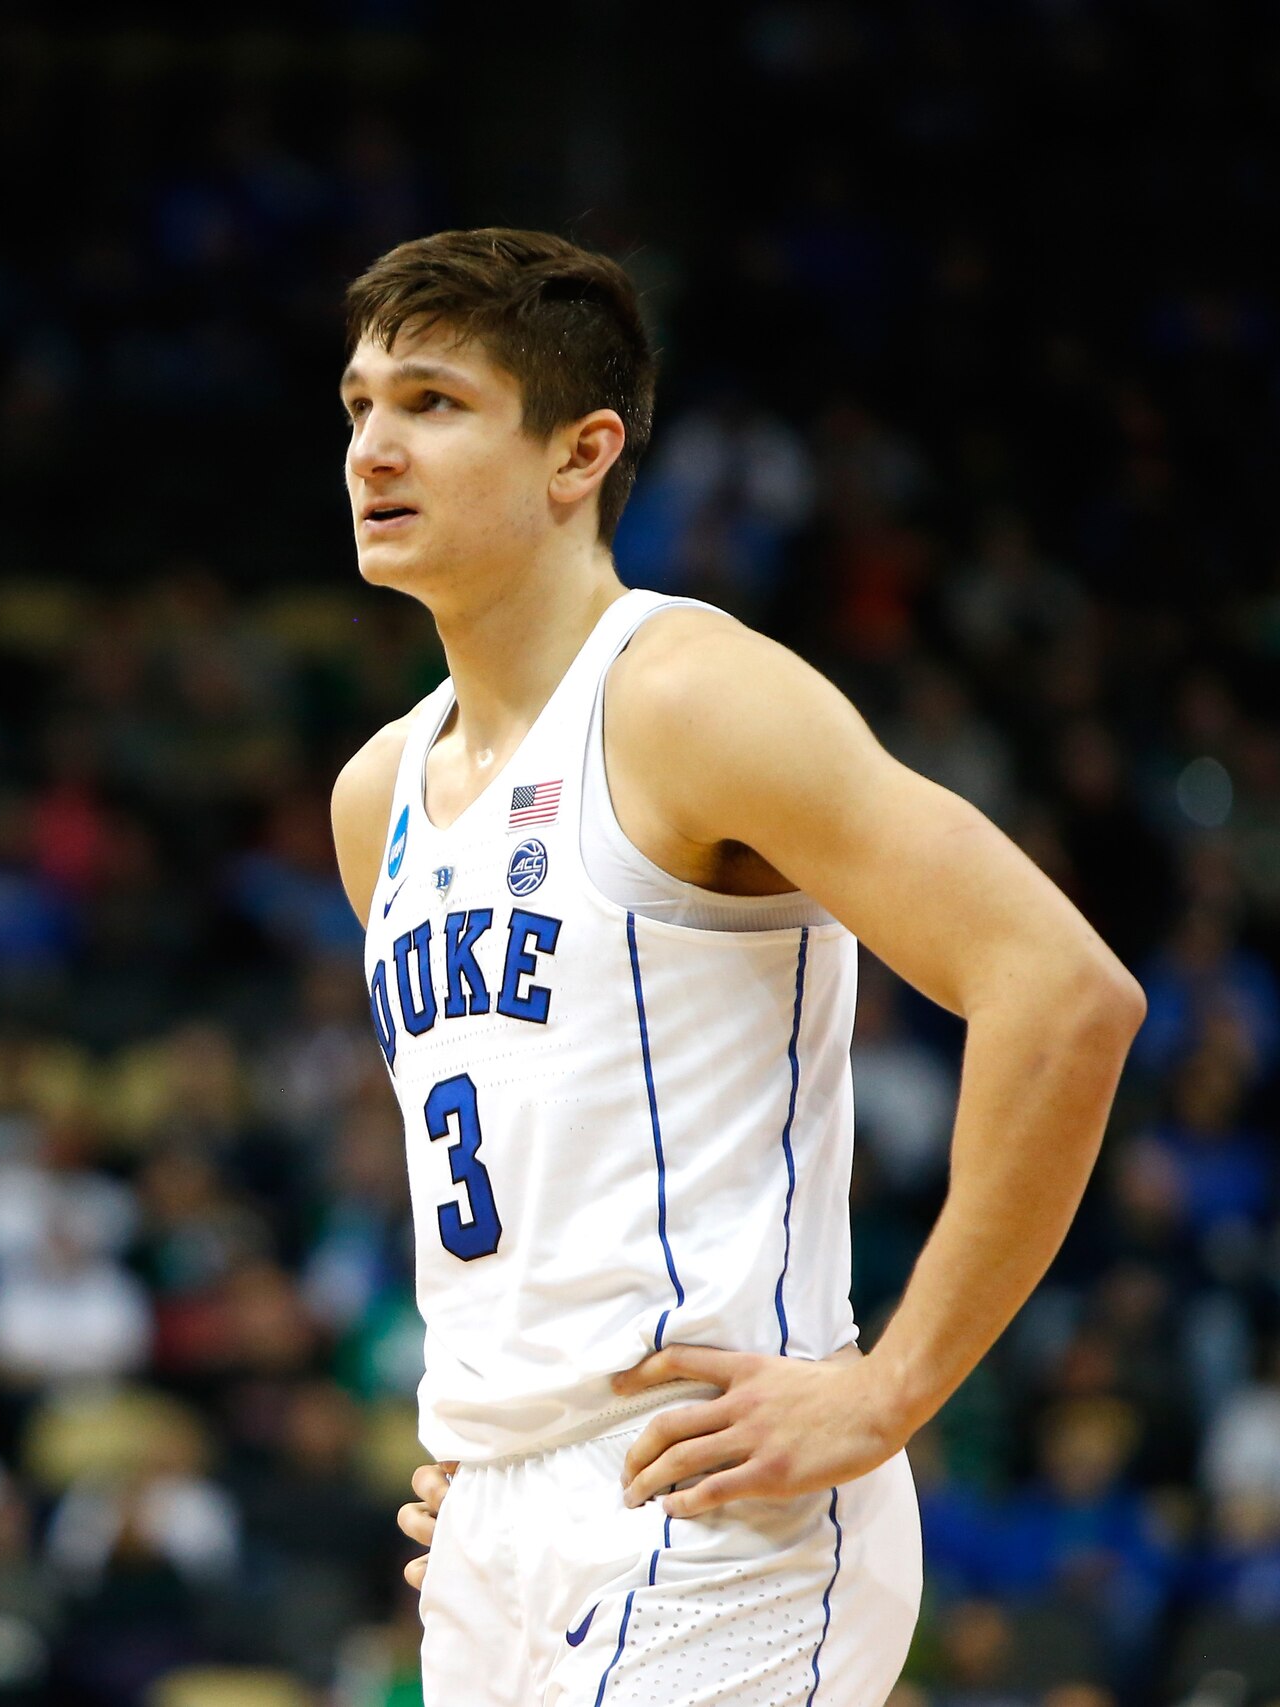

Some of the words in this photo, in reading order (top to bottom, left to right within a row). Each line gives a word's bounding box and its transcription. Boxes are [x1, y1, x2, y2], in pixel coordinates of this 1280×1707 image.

[513, 855, 545, 872] ACC
[371, 908, 562, 1075] DUKE
[424, 1073, 502, 1261] 3
